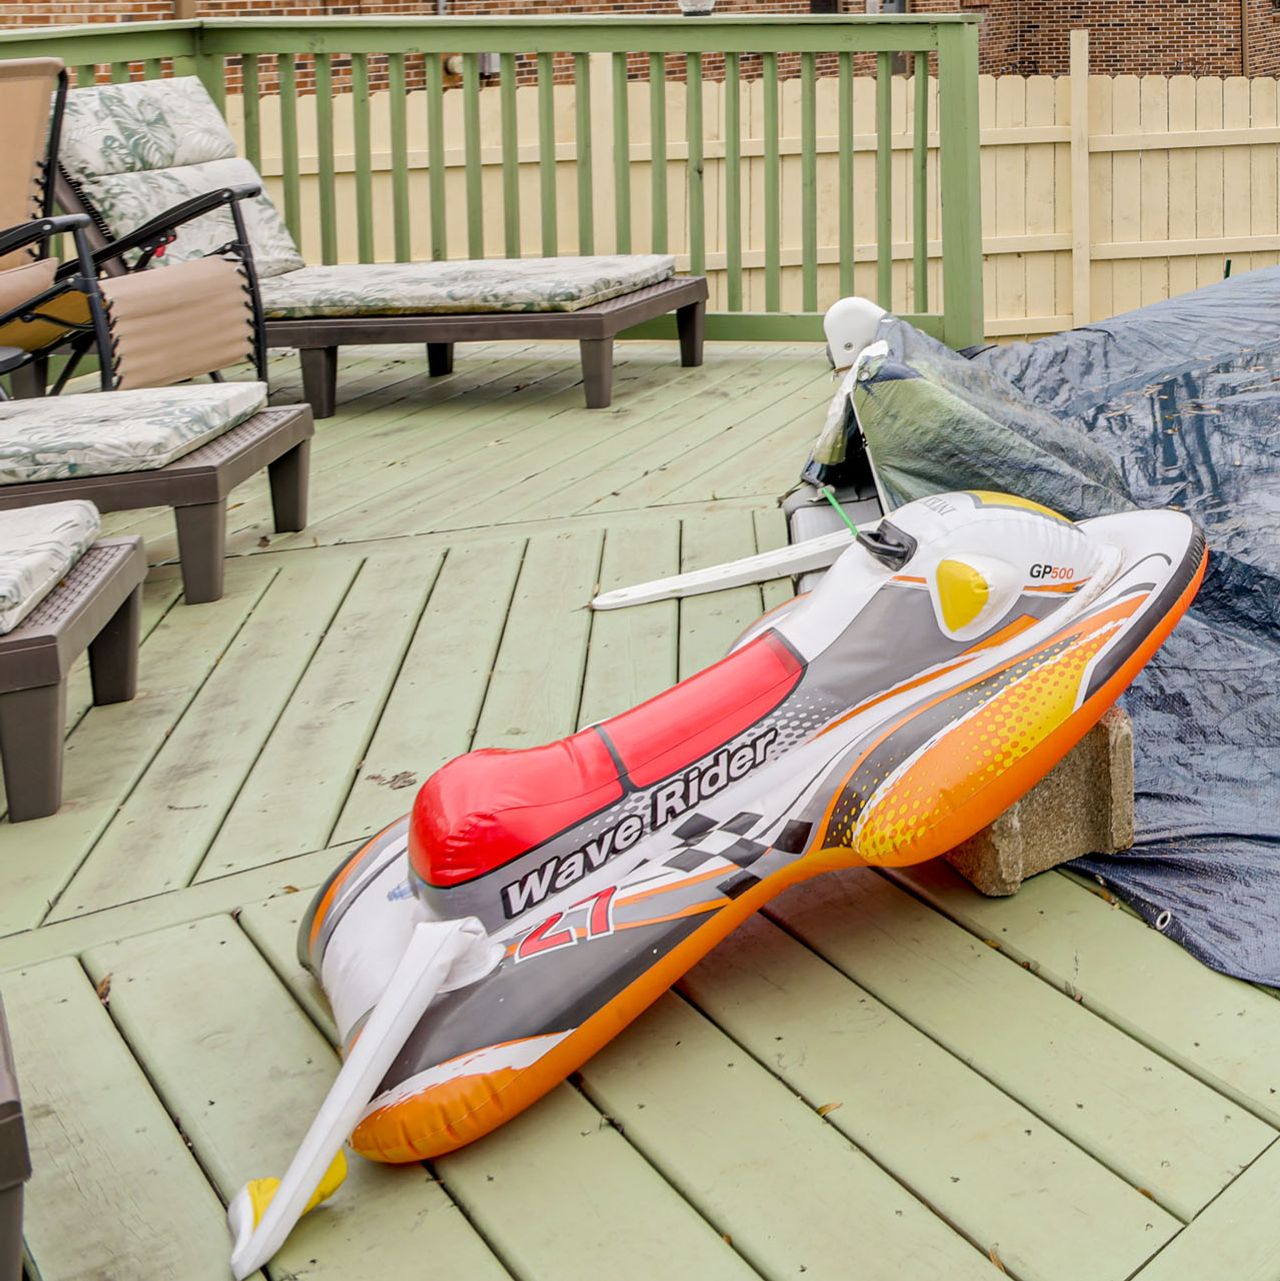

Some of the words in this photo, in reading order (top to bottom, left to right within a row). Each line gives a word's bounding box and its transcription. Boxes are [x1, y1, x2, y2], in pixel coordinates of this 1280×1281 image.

[1029, 563, 1074, 580] GP500
[502, 815, 644, 919] Wave
[651, 728, 778, 830] Rider
[515, 885, 617, 963] 27
